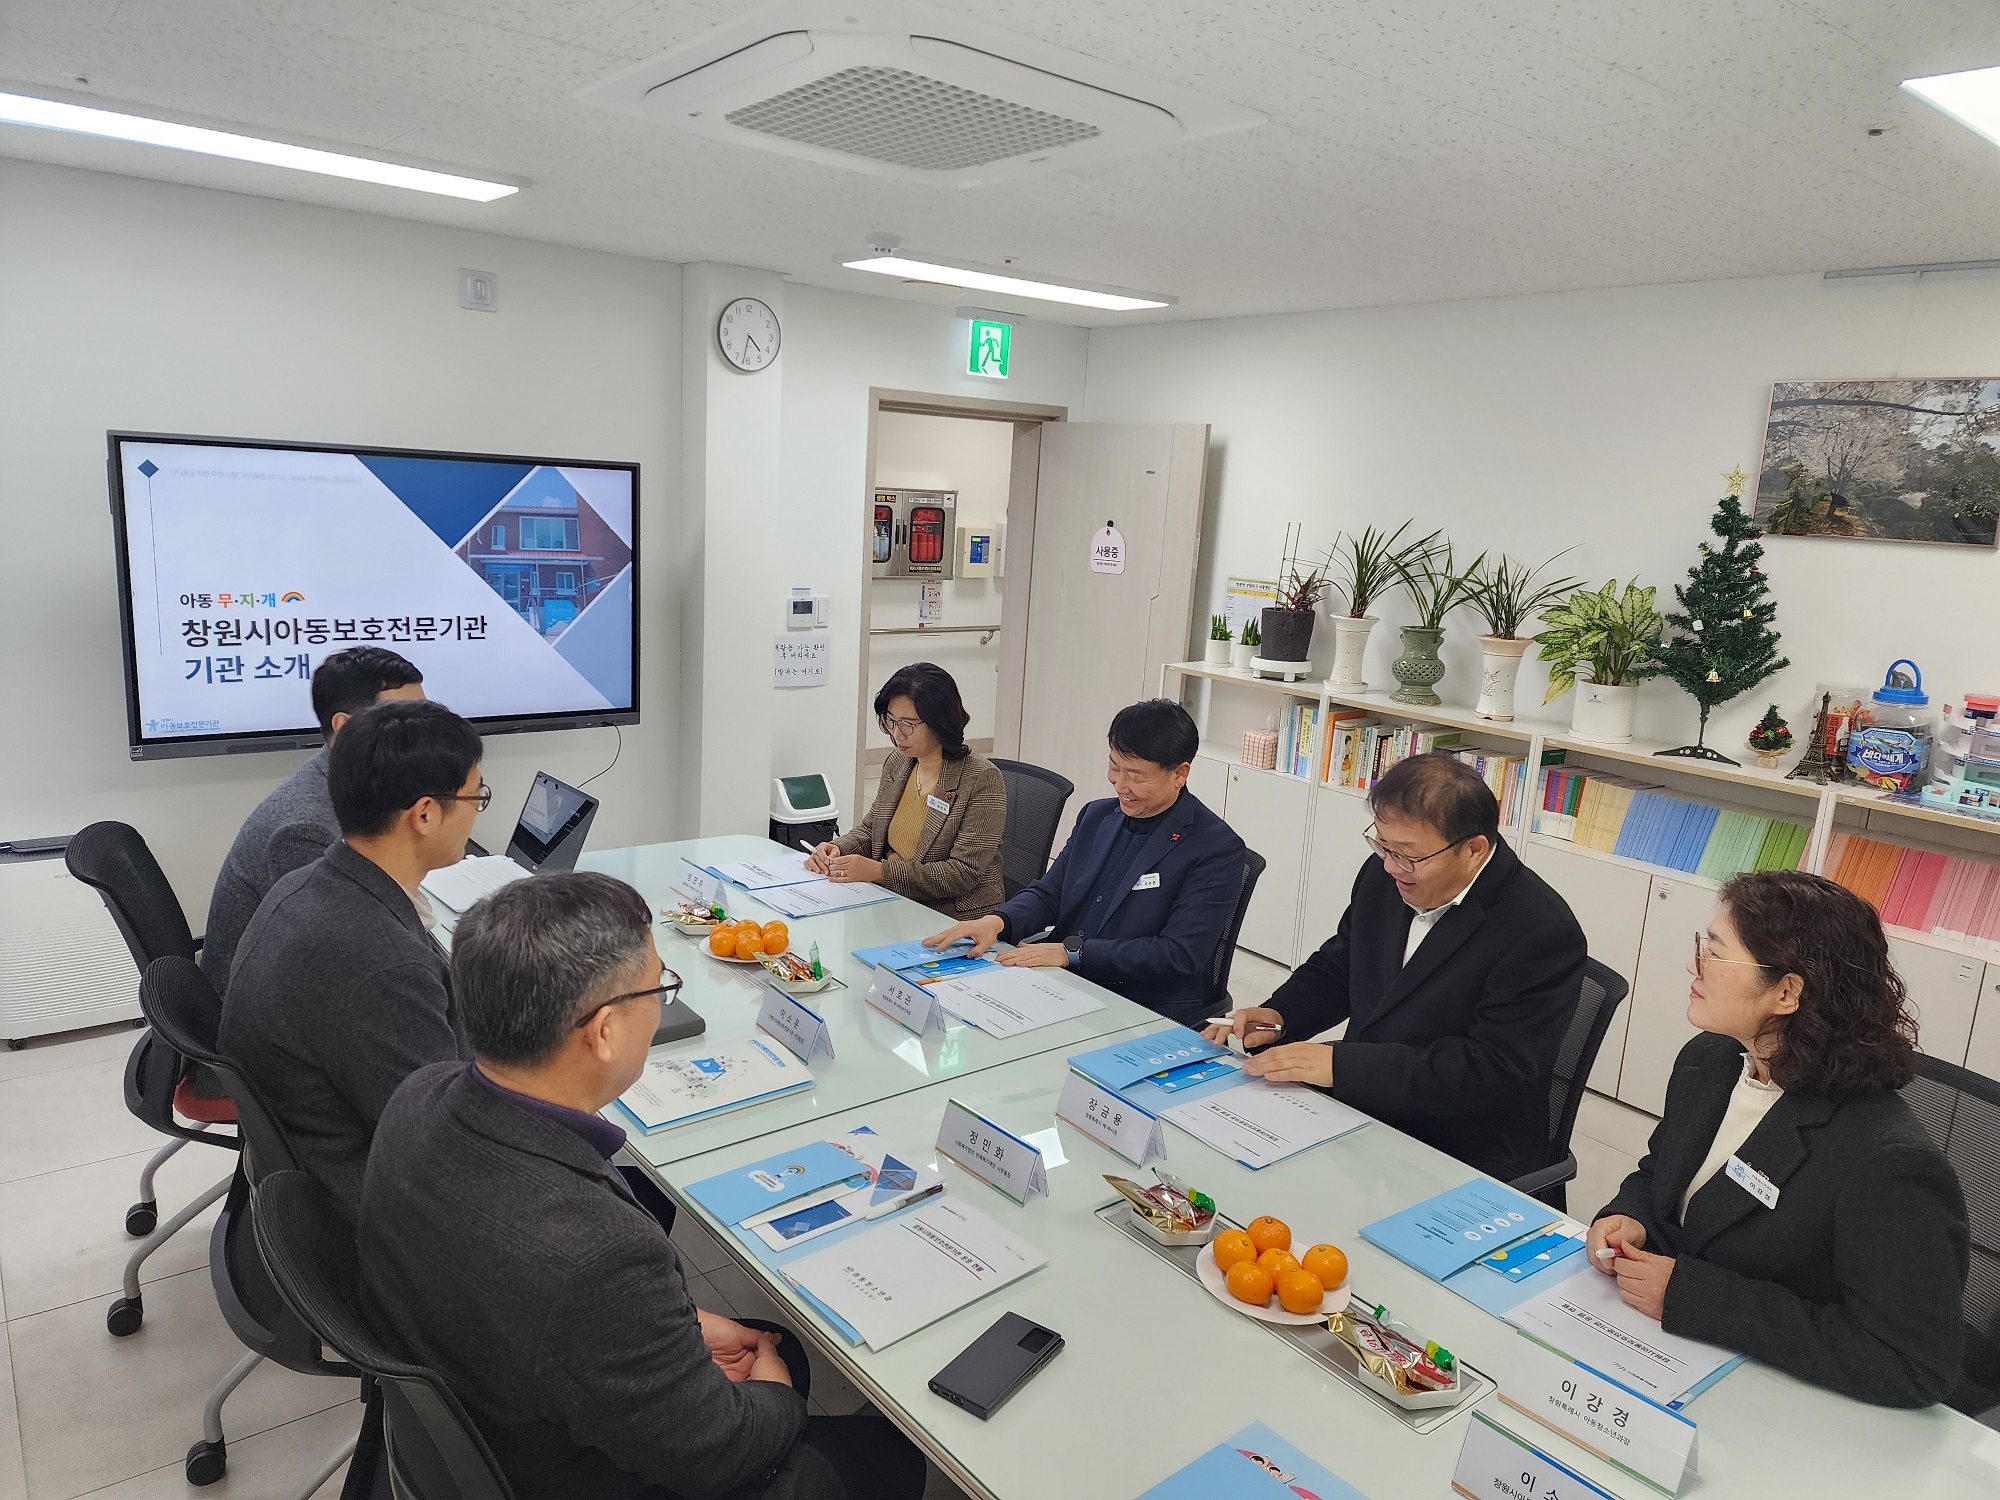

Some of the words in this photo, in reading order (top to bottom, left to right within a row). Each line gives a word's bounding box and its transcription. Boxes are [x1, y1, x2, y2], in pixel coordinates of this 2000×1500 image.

[1095, 545, 1119, 559] 사용중
[180, 592, 213, 609] 아동
[181, 615, 488, 648] 창원시아동보호전문기관
[184, 654, 245, 685] 기관
[254, 652, 311, 681] 소개
[160, 719, 219, 732] 아동보호전문기관
[1088, 1097, 1122, 1127] 장금용
[969, 1129, 1005, 1162] 정민화
[1561, 1380, 1630, 1428] 이강경
[1548, 1395, 1581, 1419] 창원특례시
[1583, 1415, 1631, 1447] 아동청소년과장
